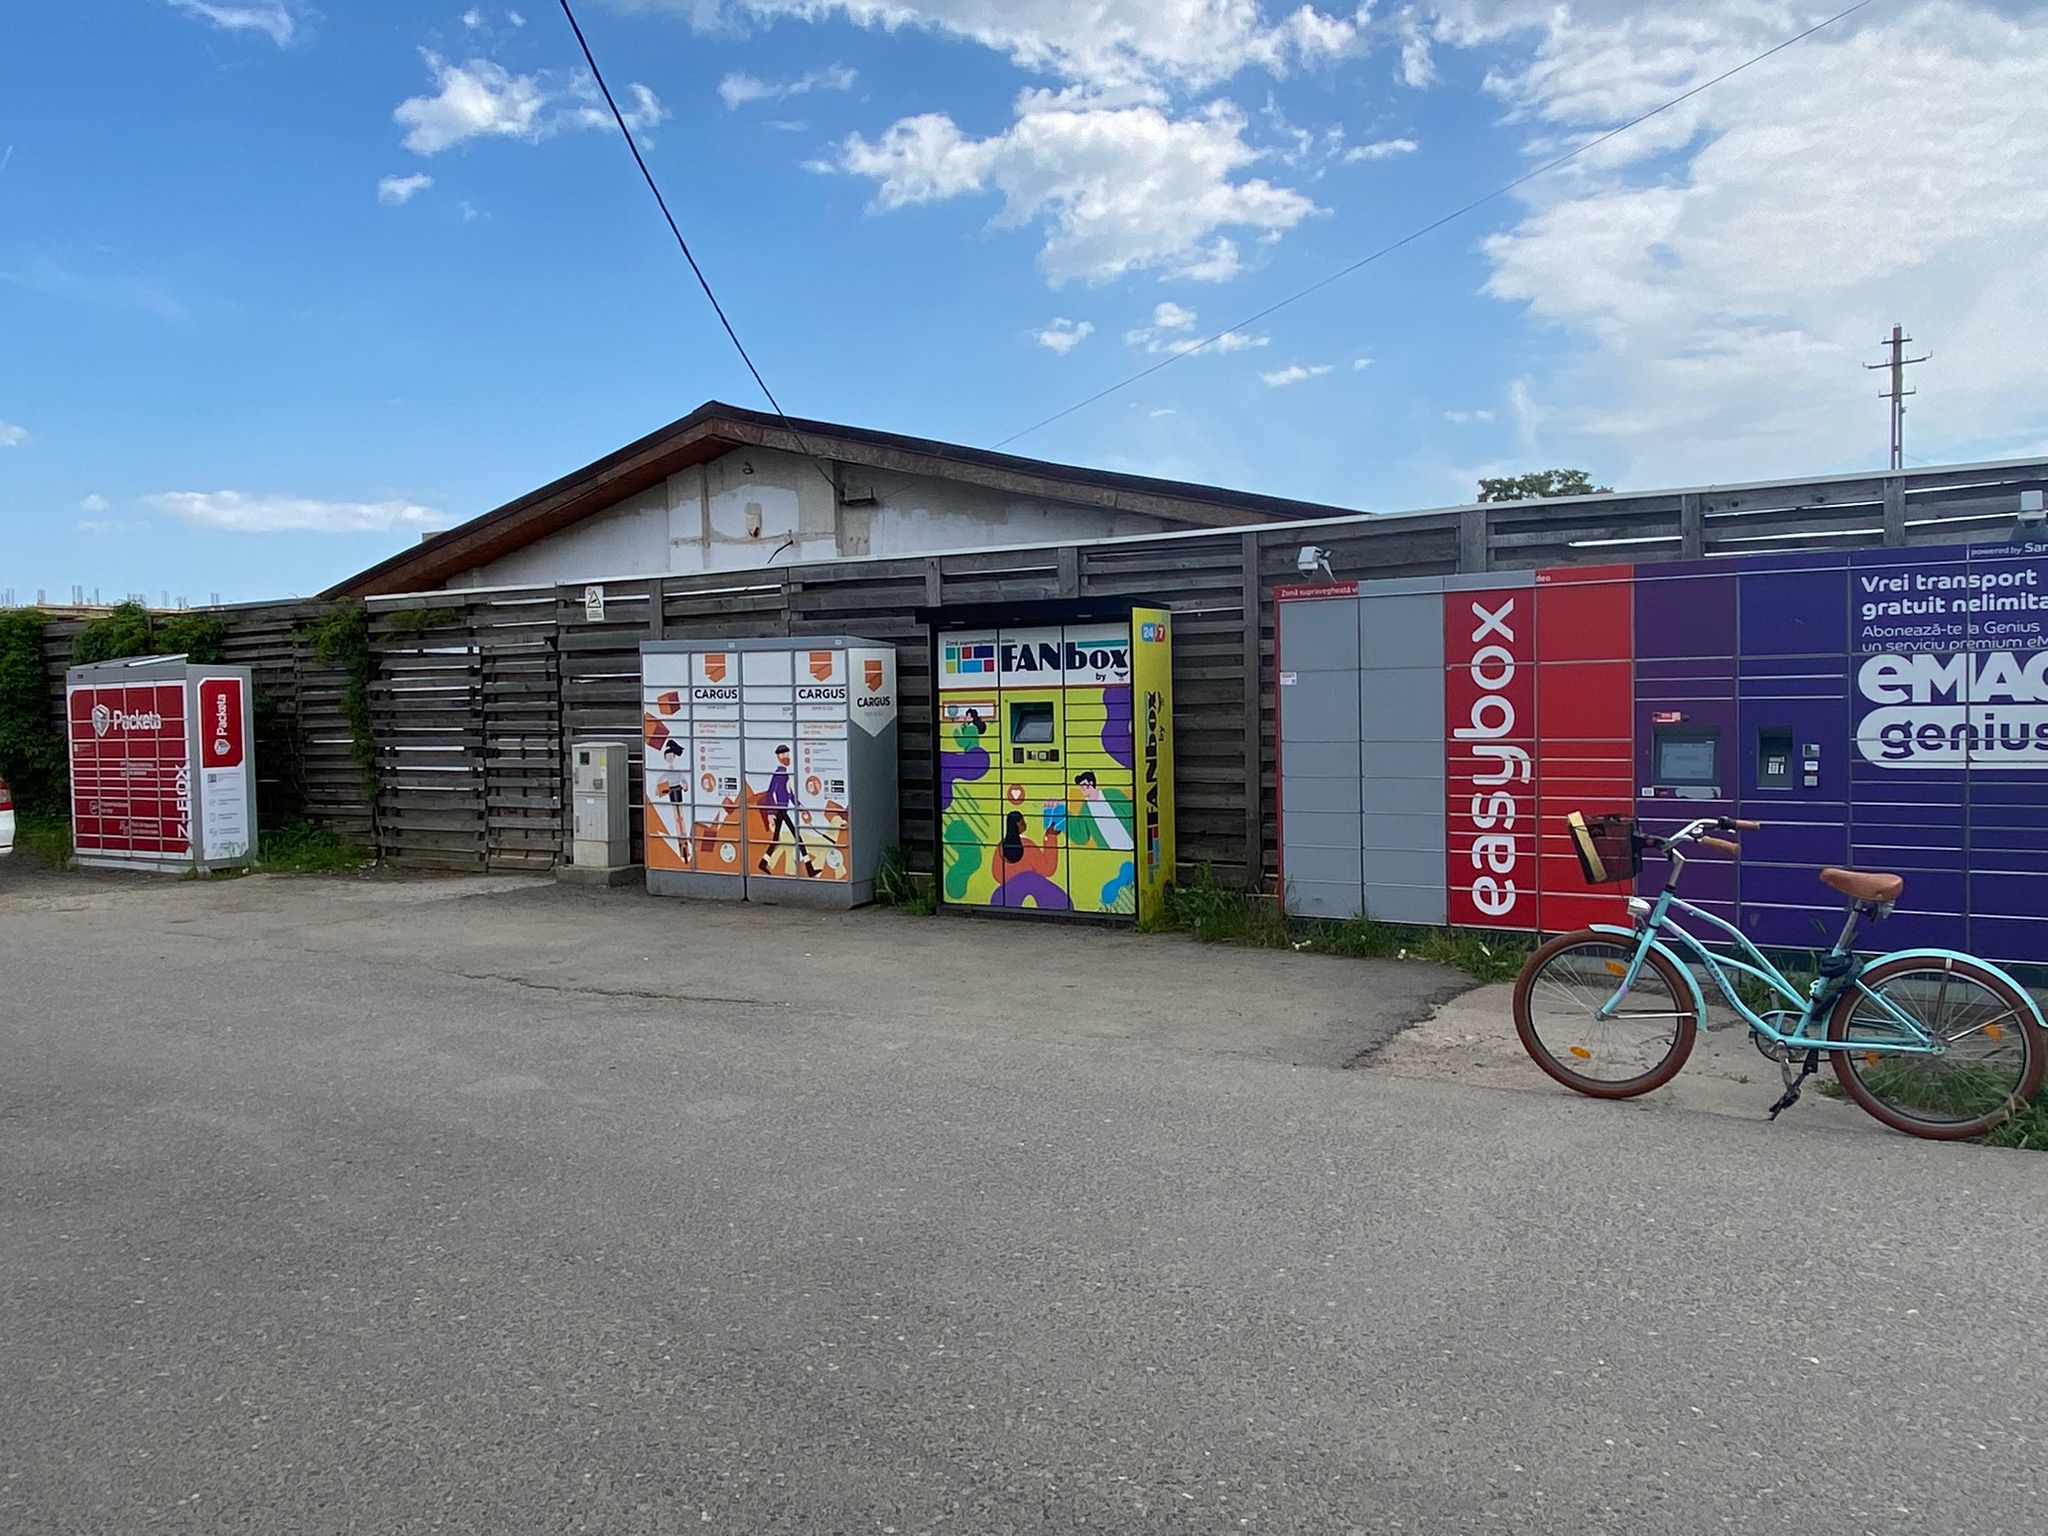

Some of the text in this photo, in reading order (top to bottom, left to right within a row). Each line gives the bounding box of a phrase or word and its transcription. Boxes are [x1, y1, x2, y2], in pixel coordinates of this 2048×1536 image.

[1971, 546, 2009, 557] powered
[2011, 546, 2022, 555] by
[1861, 569, 2038, 593] Vrei transport
[1862, 596, 1946, 621] gratuit
[1862, 623, 1963, 638] Abonează-te
[1983, 620, 2041, 634] Genius
[1862, 642, 1882, 652] un
[1885, 638, 1945, 652] serviciu
[1950, 636, 2023, 652] premium
[1001, 641, 1129, 673] FANbox
[1095, 672, 1107, 682] by
[694, 689, 738, 700] CARGUS
[798, 688, 846, 699] CARGUS
[857, 696, 891, 708] CARGUS
[113, 709, 162, 731] Packeta
[216, 693, 227, 736] Packeta
[1453, 598, 1531, 916] easybox
